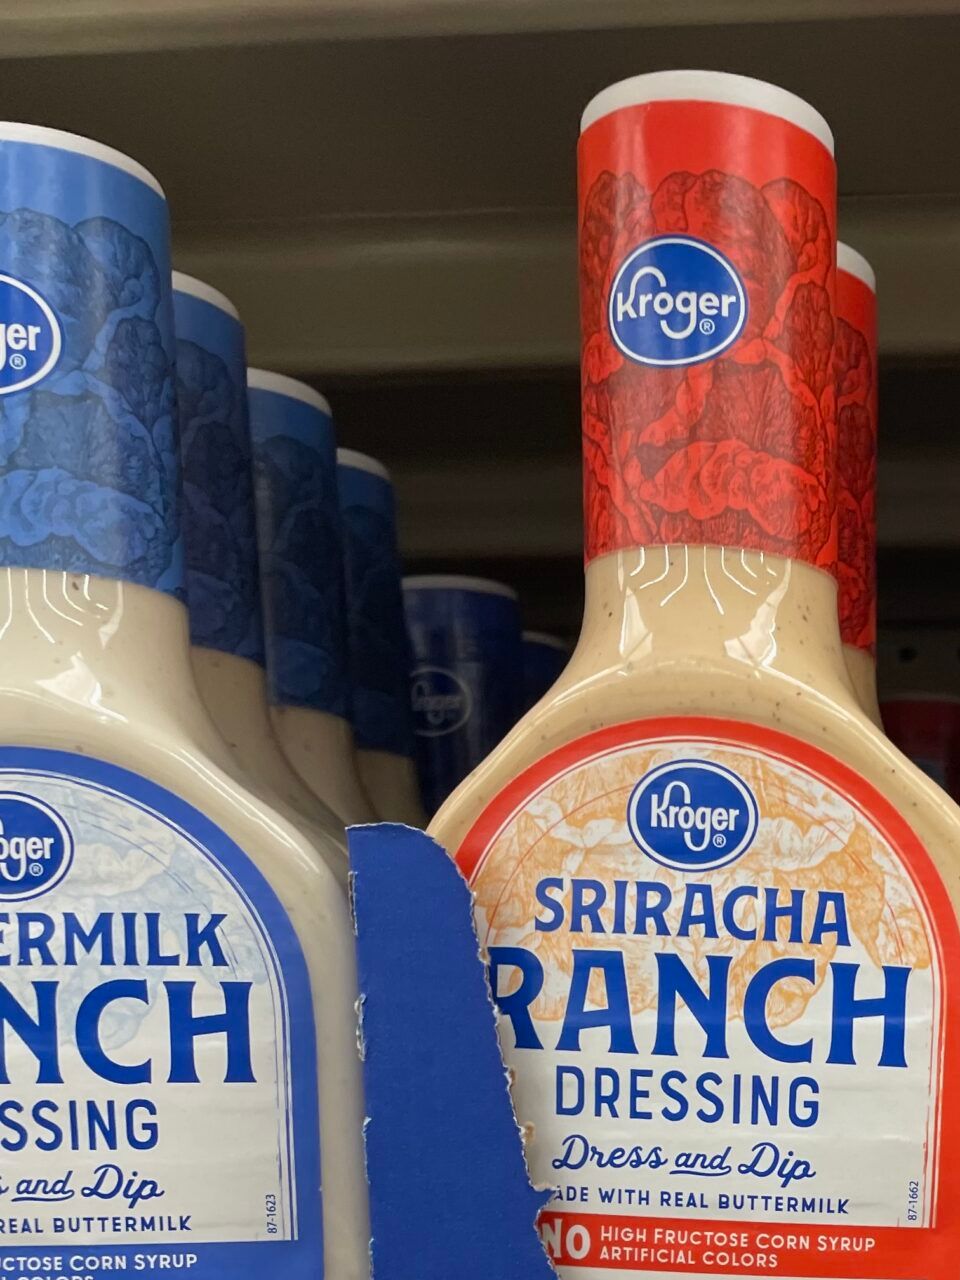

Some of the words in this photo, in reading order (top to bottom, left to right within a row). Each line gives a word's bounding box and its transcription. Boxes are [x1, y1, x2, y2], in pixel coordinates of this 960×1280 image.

[617, 266, 736, 339] Kroger
[650, 781, 739, 851] Kroger
[535, 877, 851, 947] SRIRACHA
[487, 946, 912, 1069] RANCH
[555, 1065, 820, 1128] DRESSING
[552, 1134, 668, 1170] Dress
[670, 1146, 731, 1177] and
[738, 1142, 816, 1188] Dip
[11, 1170, 74, 1203] and
[81, 1164, 164, 1208] Dip
[598, 1187, 650, 1206] WITH
[660, 1193, 709, 1209] REAL
[718, 1194, 850, 1214] BUTTERMILK
[908, 1180, 919, 1221] 87-1662
[53, 1215, 192, 1233] BUTTERMILK
[265, 1193, 277, 1234] 87-1623
[541, 1218, 591, 1260] NO
[599, 1245, 697, 1265] ARTIFICIAL
[702, 1250, 778, 1268] COLORS
[600, 1225, 647, 1243] HIGH
[654, 1229, 749, 1248] FRUCTOSE
[756, 1233, 811, 1251] CORN
[817, 1235, 876, 1252] SYRUP
[69, 1255, 127, 1271] CORN
[134, 1254, 198, 1270] SYRUP
